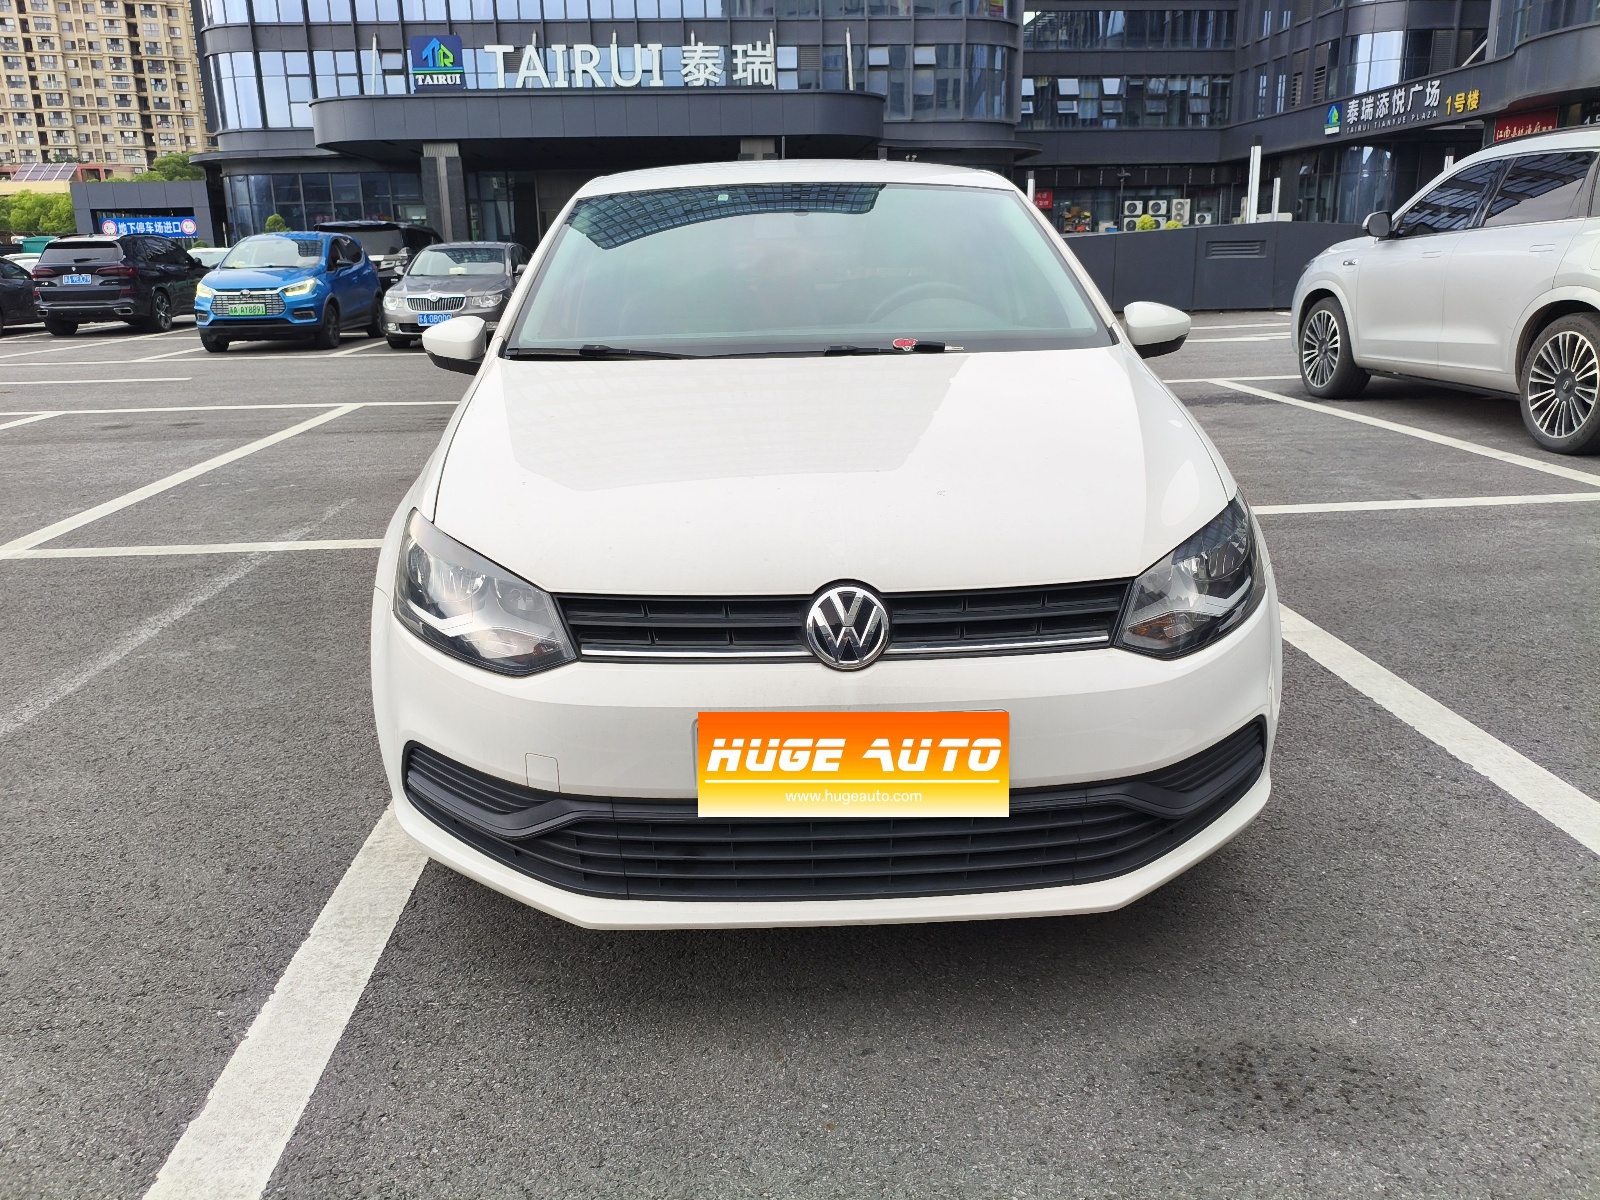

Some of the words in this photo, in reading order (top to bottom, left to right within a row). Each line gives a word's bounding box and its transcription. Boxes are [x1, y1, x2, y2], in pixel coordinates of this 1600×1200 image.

[415, 74, 461, 86] TAIRUI
[484, 43, 663, 88] TAIRUI
[680, 41, 775, 87] 泰瑞
[1346, 79, 1442, 124] 泰瑞添悦广场
[1445, 89, 1481, 115] 1号楼
[1346, 125, 1371, 134] TAIRUI
[1411, 110, 1438, 121] PLAZA
[117, 221, 182, 235] 地下停车场进口
